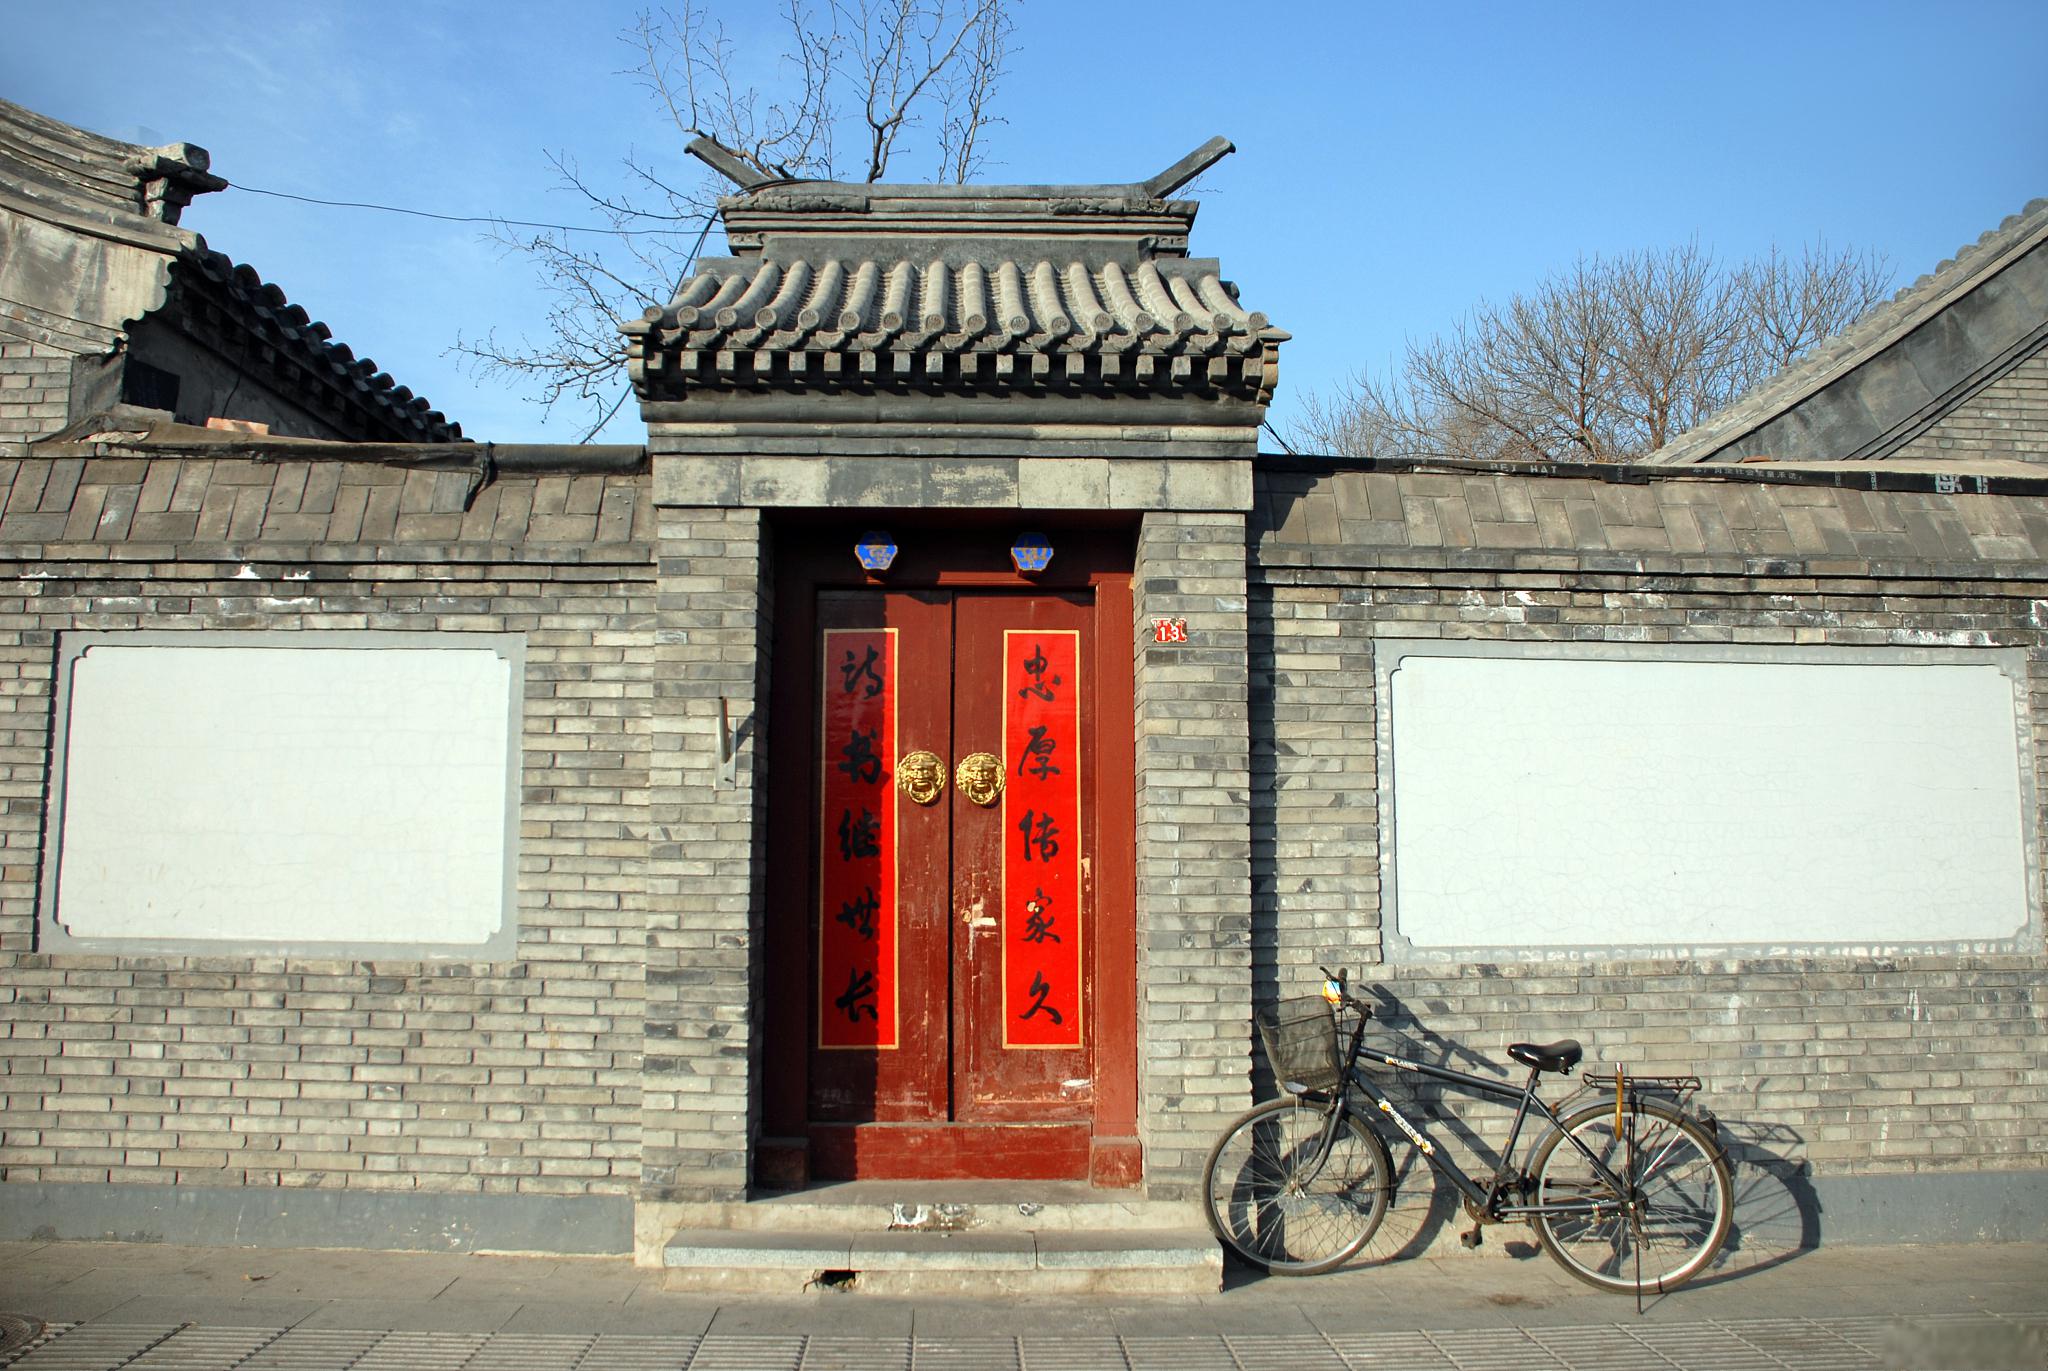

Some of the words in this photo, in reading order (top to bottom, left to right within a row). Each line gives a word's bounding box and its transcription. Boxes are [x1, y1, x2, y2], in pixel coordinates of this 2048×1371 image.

[1160, 626, 1179, 641] 13
[1018, 644, 1062, 1025] 忠厚传家久
